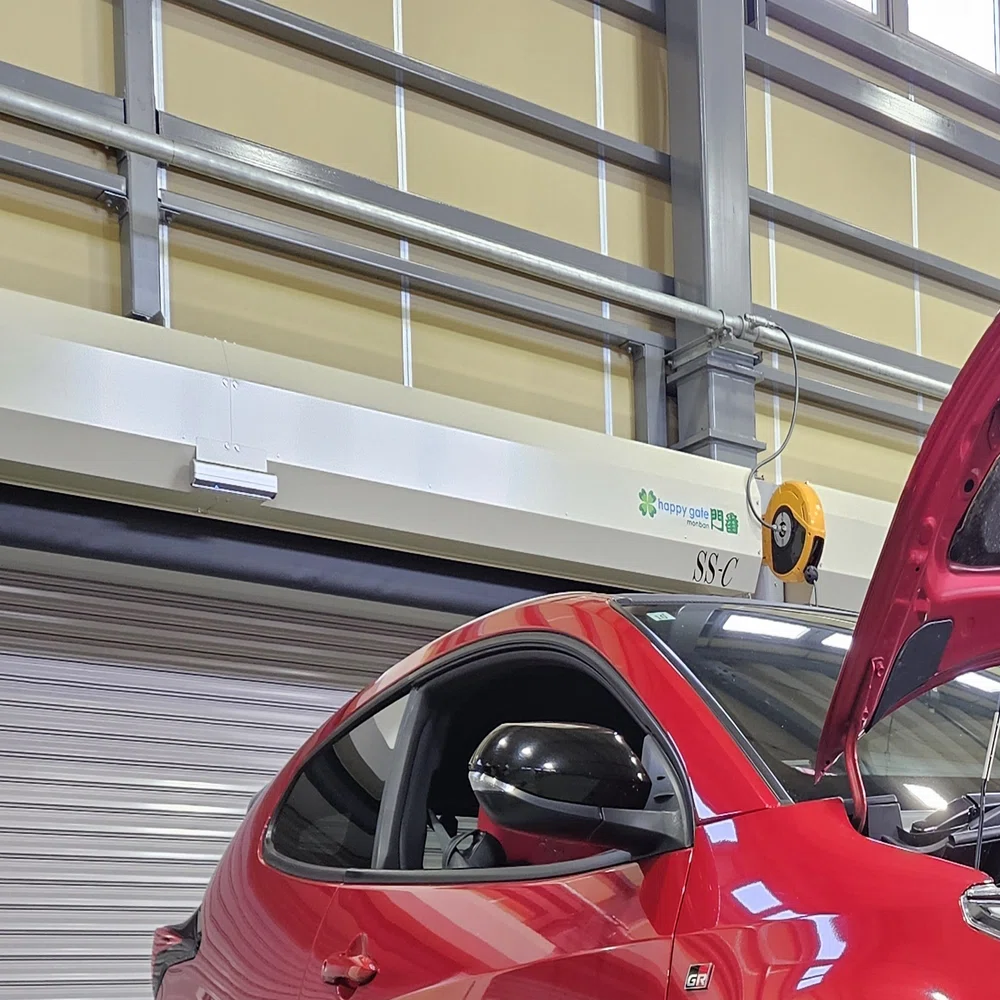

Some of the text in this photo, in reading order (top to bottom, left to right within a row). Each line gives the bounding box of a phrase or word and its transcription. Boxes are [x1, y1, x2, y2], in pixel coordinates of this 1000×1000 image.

[657, 498, 739, 535] happy gate 門番
[687, 519, 710, 529] monban
[692, 550, 739, 587] SS-C
[686, 973, 708, 987] GR
